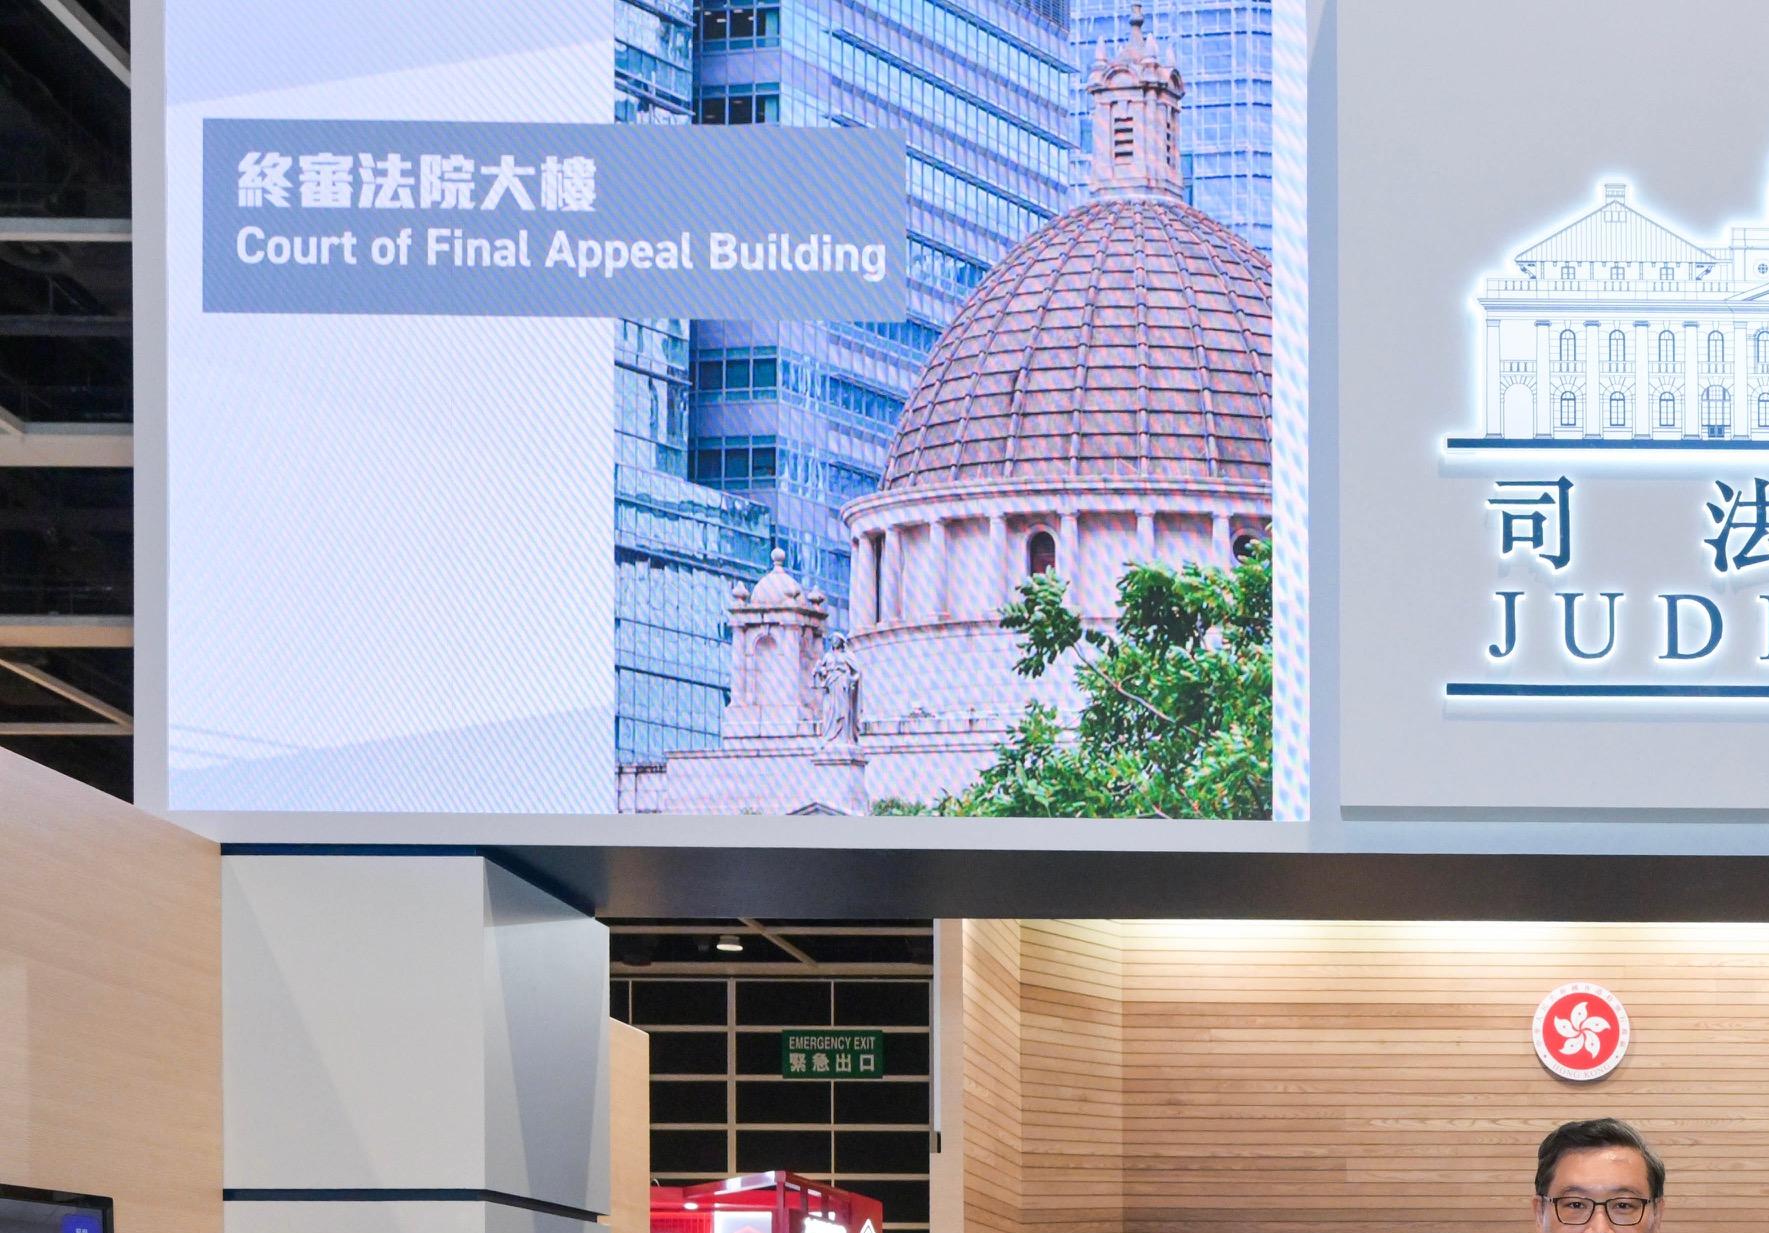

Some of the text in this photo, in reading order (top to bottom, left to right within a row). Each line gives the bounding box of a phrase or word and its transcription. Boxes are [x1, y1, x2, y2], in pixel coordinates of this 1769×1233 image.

[238, 152, 597, 211] 終審法院大樓
[237, 226, 886, 282] Court of Final Appeal Building
[789, 1037, 875, 1049] EMERGENCY EXIT
[789, 1053, 875, 1072] 緊急出口
